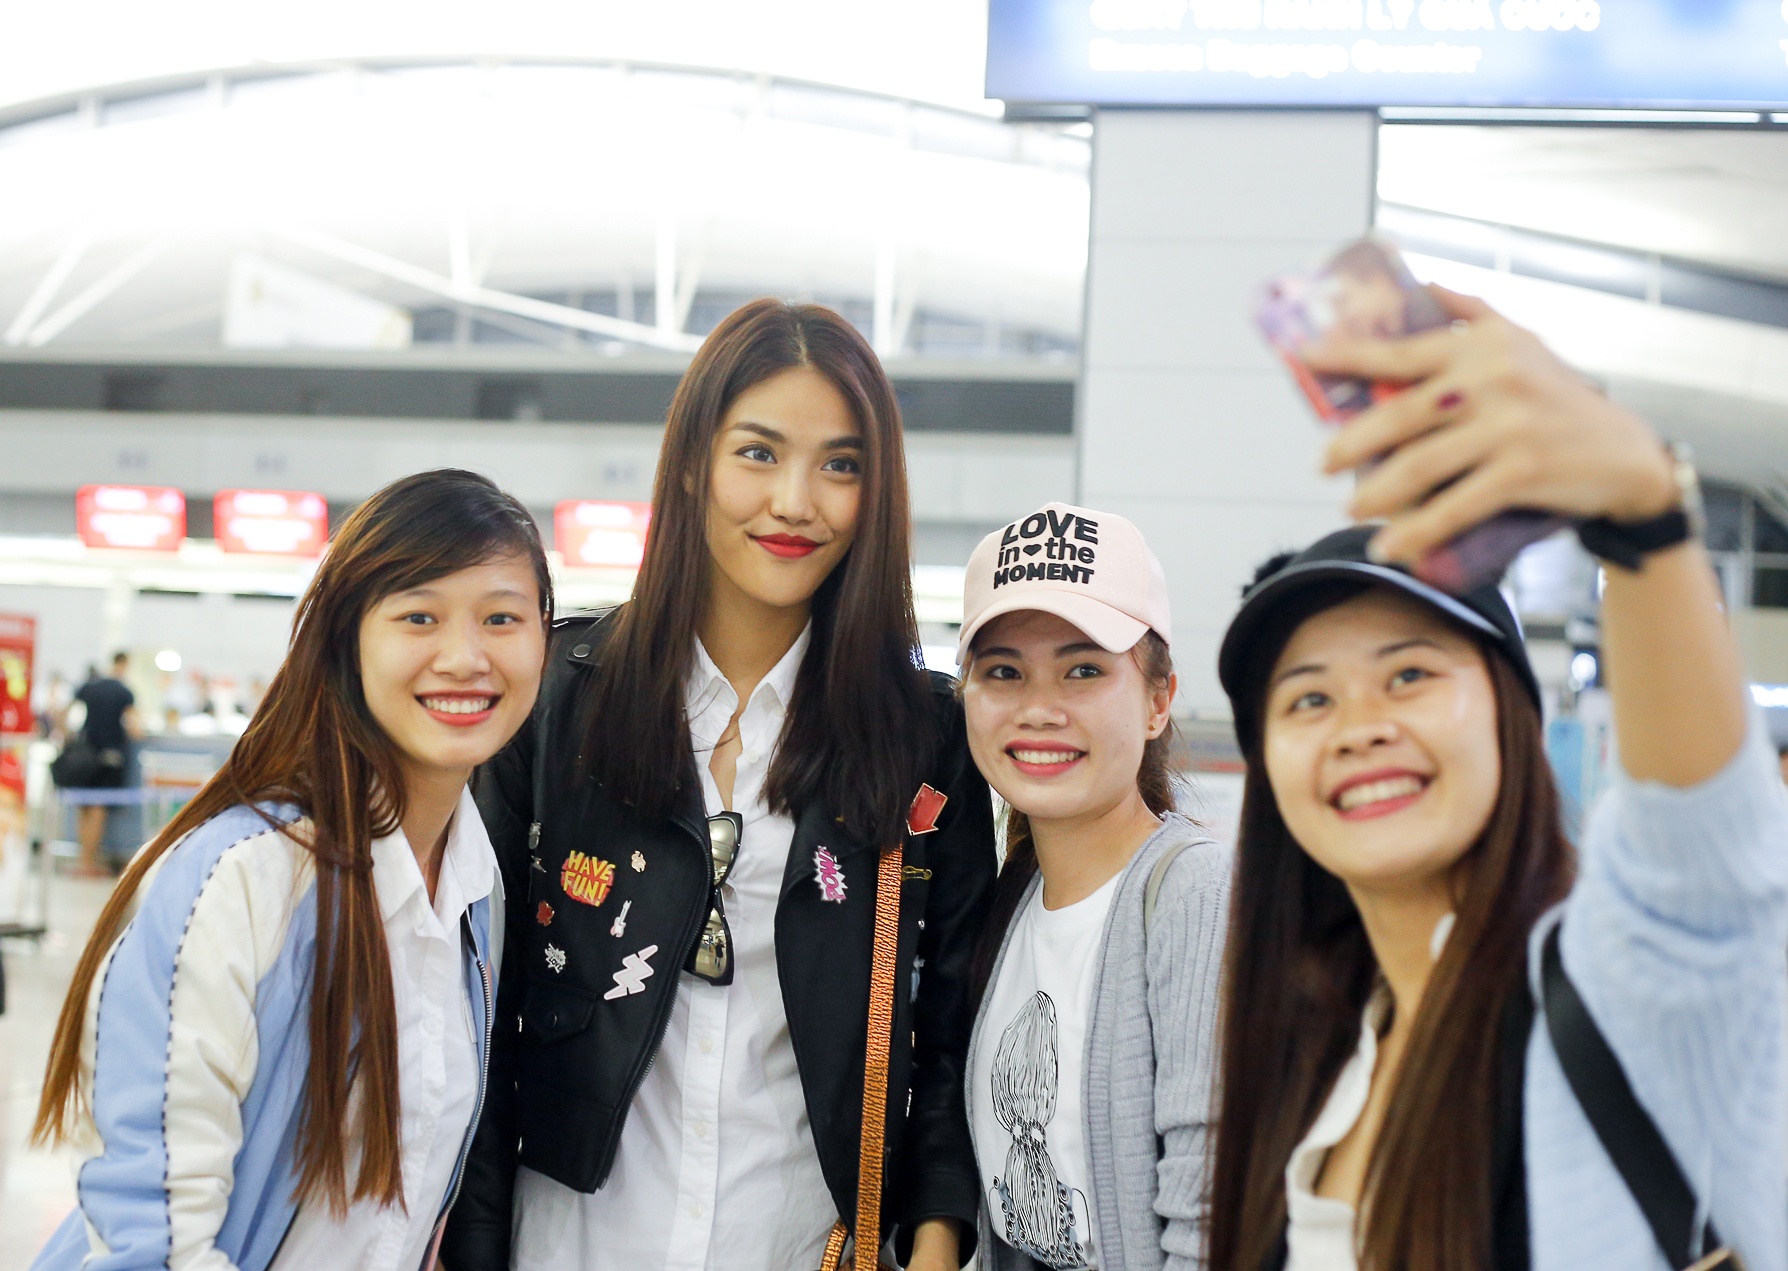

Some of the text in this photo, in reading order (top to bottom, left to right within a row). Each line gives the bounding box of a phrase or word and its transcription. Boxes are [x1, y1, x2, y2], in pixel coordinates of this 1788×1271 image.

[1001, 510, 1099, 546] LOVE
[998, 537, 1095, 568] in the
[994, 562, 1095, 590] MOMENT
[568, 850, 616, 881] HAVE
[563, 871, 607, 907] FUN!
